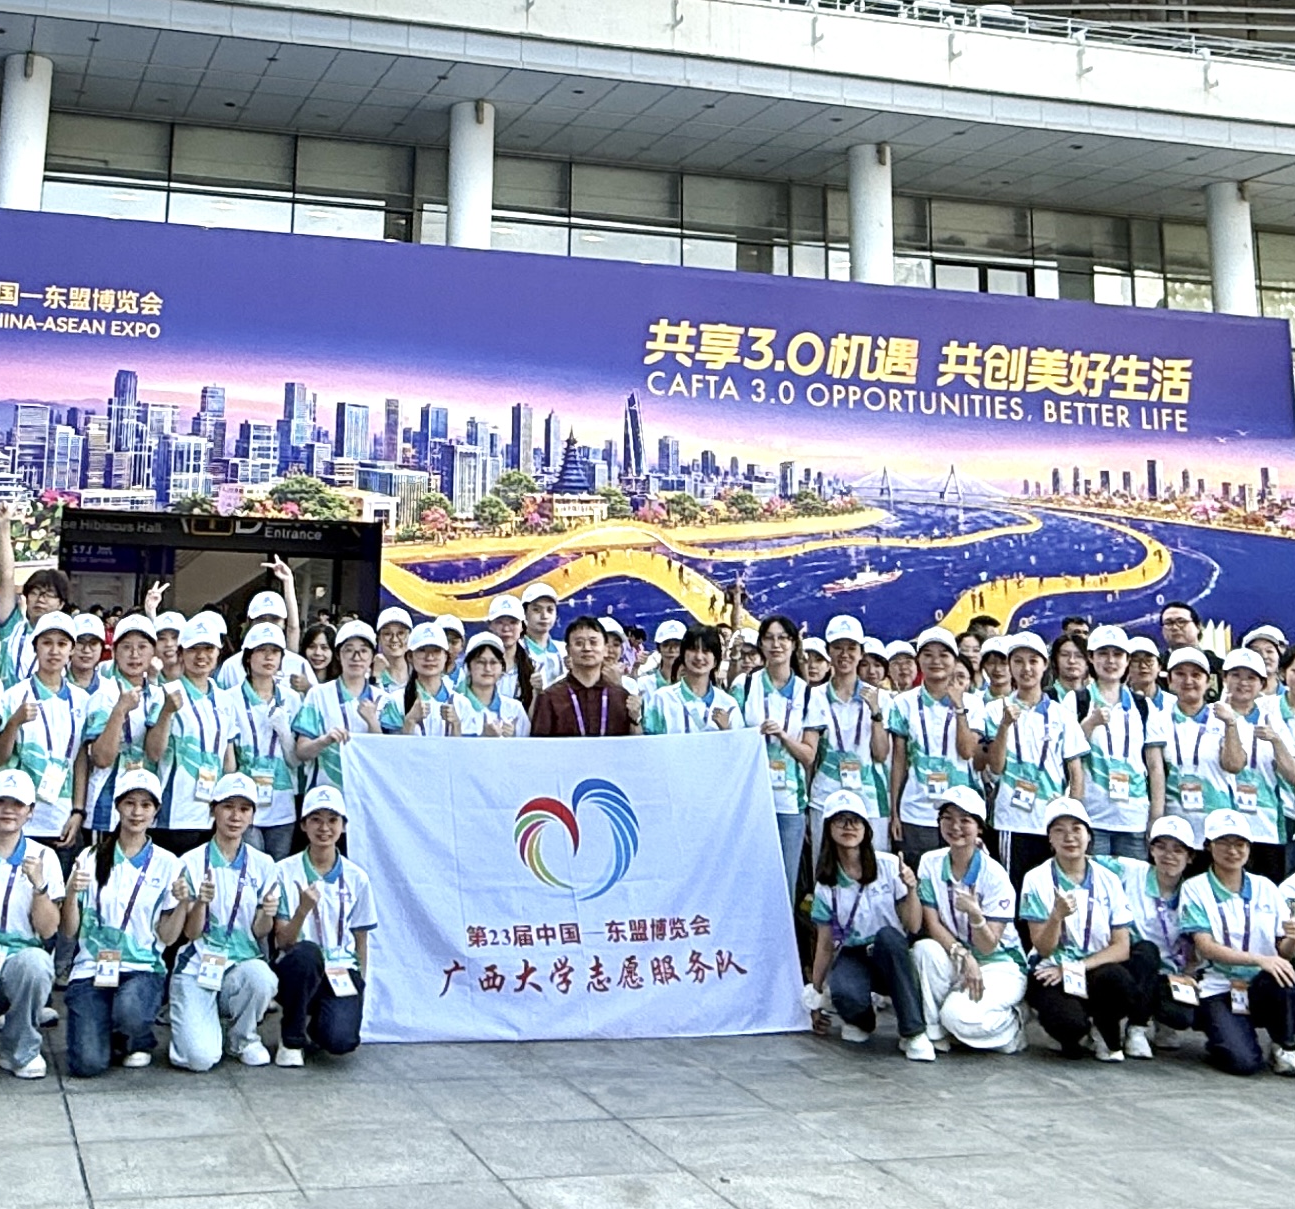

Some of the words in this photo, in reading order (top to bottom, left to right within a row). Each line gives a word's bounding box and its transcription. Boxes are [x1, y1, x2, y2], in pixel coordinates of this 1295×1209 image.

[110, 319, 161, 339] EXPO
[643, 318, 920, 385] 共享3.0机遇
[936, 340, 1193, 404] 共创美好生活
[646, 370, 741, 401] CAFTA
[750, 379, 796, 405] 3.0
[806, 382, 1033, 422] OPPORTUNITIES,
[1043, 399, 1131, 428] BETTER
[1141, 406, 1189, 432] LIFE
[136, 521, 162, 533] Hall
[264, 525, 323, 541] Entrance
[438, 948, 748, 998] 广西大学志愿服务队
